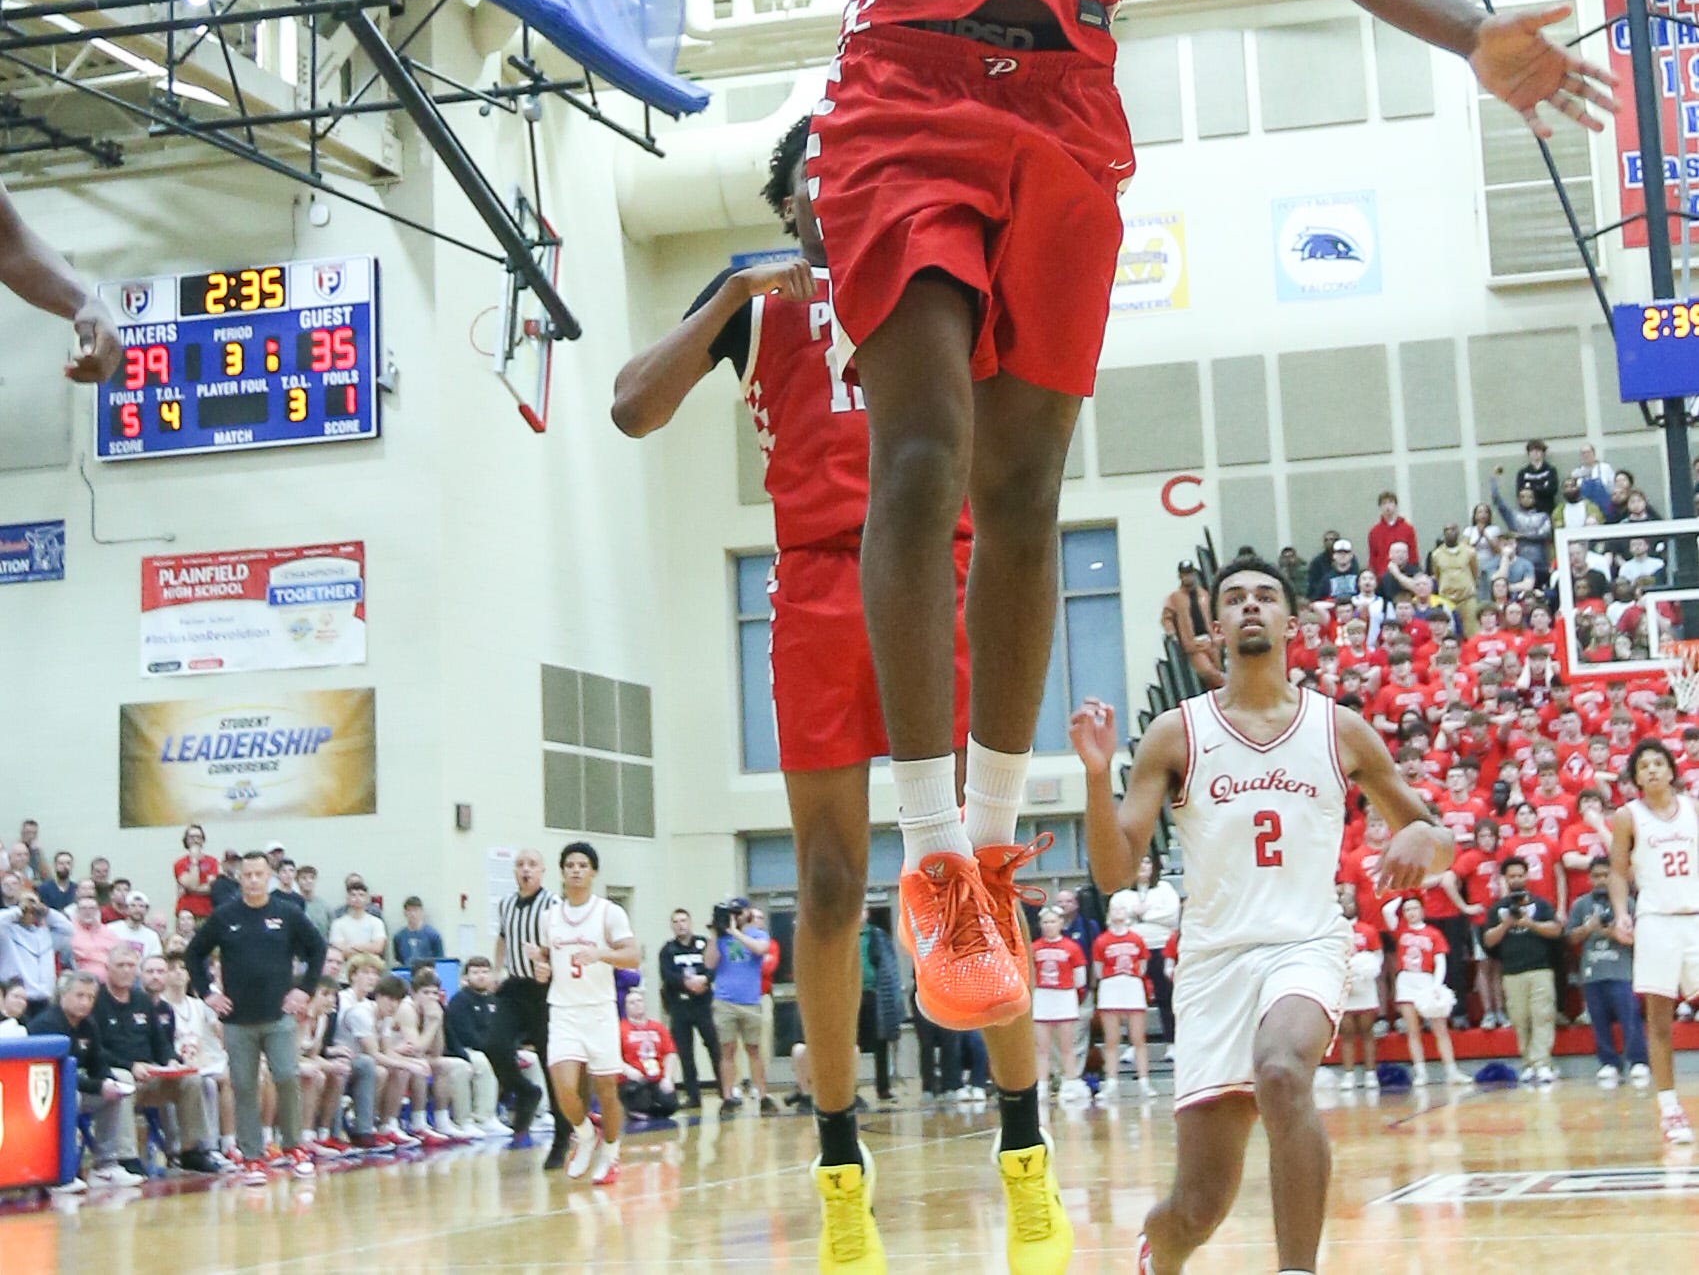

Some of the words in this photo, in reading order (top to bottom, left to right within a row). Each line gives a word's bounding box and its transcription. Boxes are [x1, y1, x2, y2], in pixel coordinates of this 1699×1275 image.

[204, 267, 285, 314] 2:35
[299, 306, 353, 328] GUEST
[213, 325, 253, 342] PERIOD
[224, 341, 244, 376] 3
[310, 326, 357, 373] 35
[125, 345, 169, 391] 39
[323, 369, 359, 386] FOULS
[109, 389, 144, 405] FOULS
[197, 381, 238, 398] PLAYER
[240, 378, 269, 393] FOUL
[344, 384, 357, 415] 1
[159, 400, 181, 431] 4
[288, 387, 308, 423] 3
[120, 402, 141, 439] 5
[323, 419, 360, 435] SCORE
[109, 438, 144, 454] SCORE
[213, 429, 253, 444] MATCH
[1160, 474, 1206, 517] C
[158, 563, 249, 587] PLAINFIELD
[162, 585, 192, 600] HIGH
[194, 582, 244, 598] SCHOOL
[273, 583, 357, 604] TOGETHER
[219, 715, 271, 730] STUDENT
[160, 725, 334, 763] LEADERSHIP
[208, 760, 281, 775] CONFERENCE
[1209, 767, 1320, 805] Quakers
[1253, 809, 1283, 867] 2
[1663, 850, 1689, 877] 22
